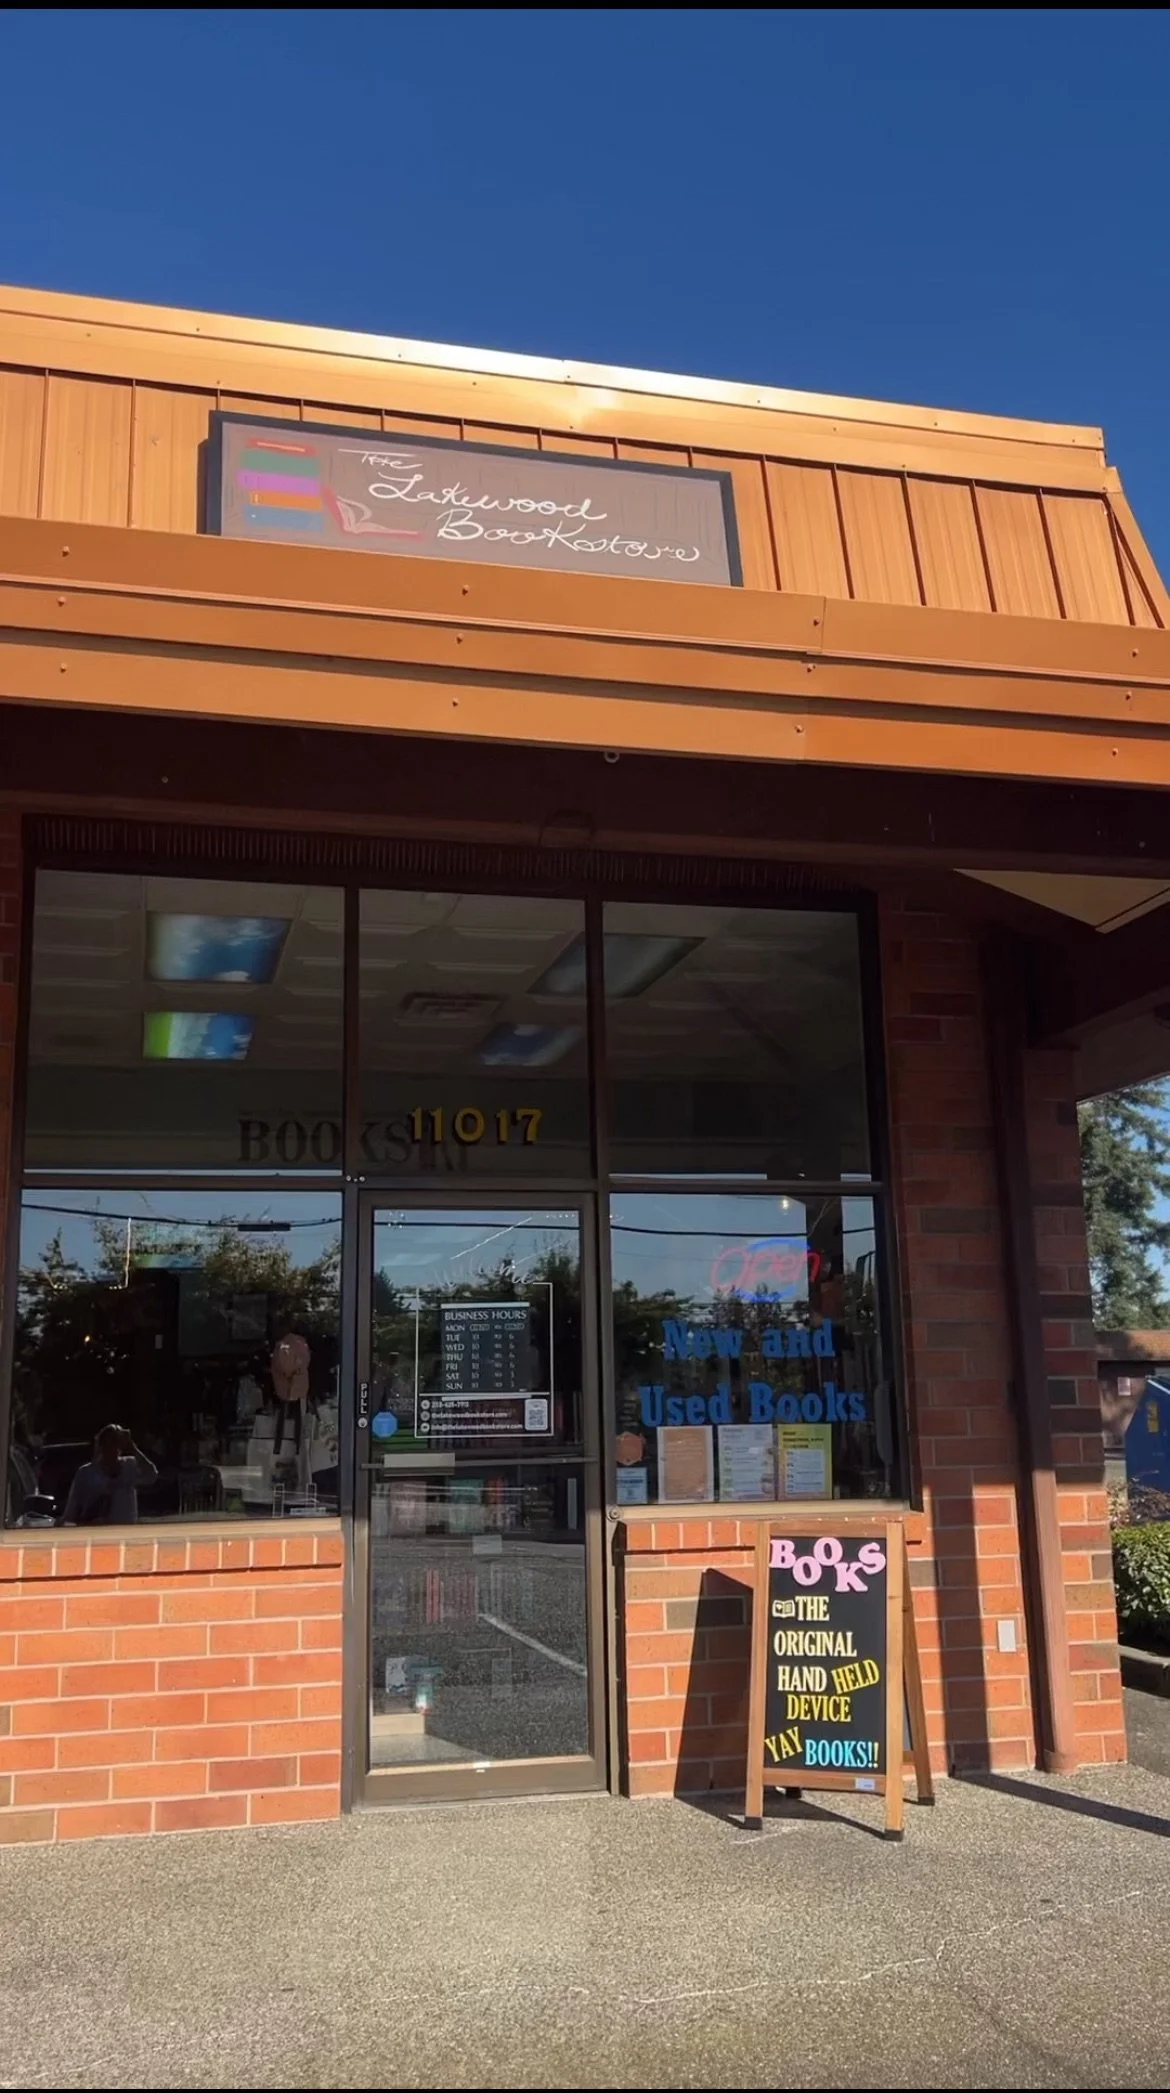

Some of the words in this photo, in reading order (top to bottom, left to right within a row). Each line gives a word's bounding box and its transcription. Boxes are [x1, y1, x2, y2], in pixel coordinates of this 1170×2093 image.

[368, 472, 607, 520] Lakewood
[710, 1246, 823, 1291] Open
[444, 1311, 489, 1321] BUSINESS
[492, 1310, 527, 1319] HOURS
[445, 1324, 466, 1332] MON
[445, 1333, 461, 1341] TUE
[445, 1343, 465, 1351] WED
[662, 1318, 744, 1360] New
[761, 1318, 836, 1358] and
[445, 1353, 464, 1361] THU
[445, 1363, 458, 1371] FRI
[445, 1372, 460, 1380] SAT
[445, 1382, 463, 1390] SUN
[360, 1383, 368, 1414] PULL
[638, 1380, 733, 1427] Used
[748, 1381, 867, 1424] Books
[768, 1536, 887, 1593] BOOKS
[794, 1596, 830, 1622] THE
[773, 1630, 857, 1658] ORIGINAL
[777, 1665, 828, 1693] HAND
[831, 1659, 880, 1695] HELD
[786, 1694, 851, 1723] DEVICE
[765, 1726, 804, 1764] YAY
[804, 1739, 880, 1769] BOOKS!!
